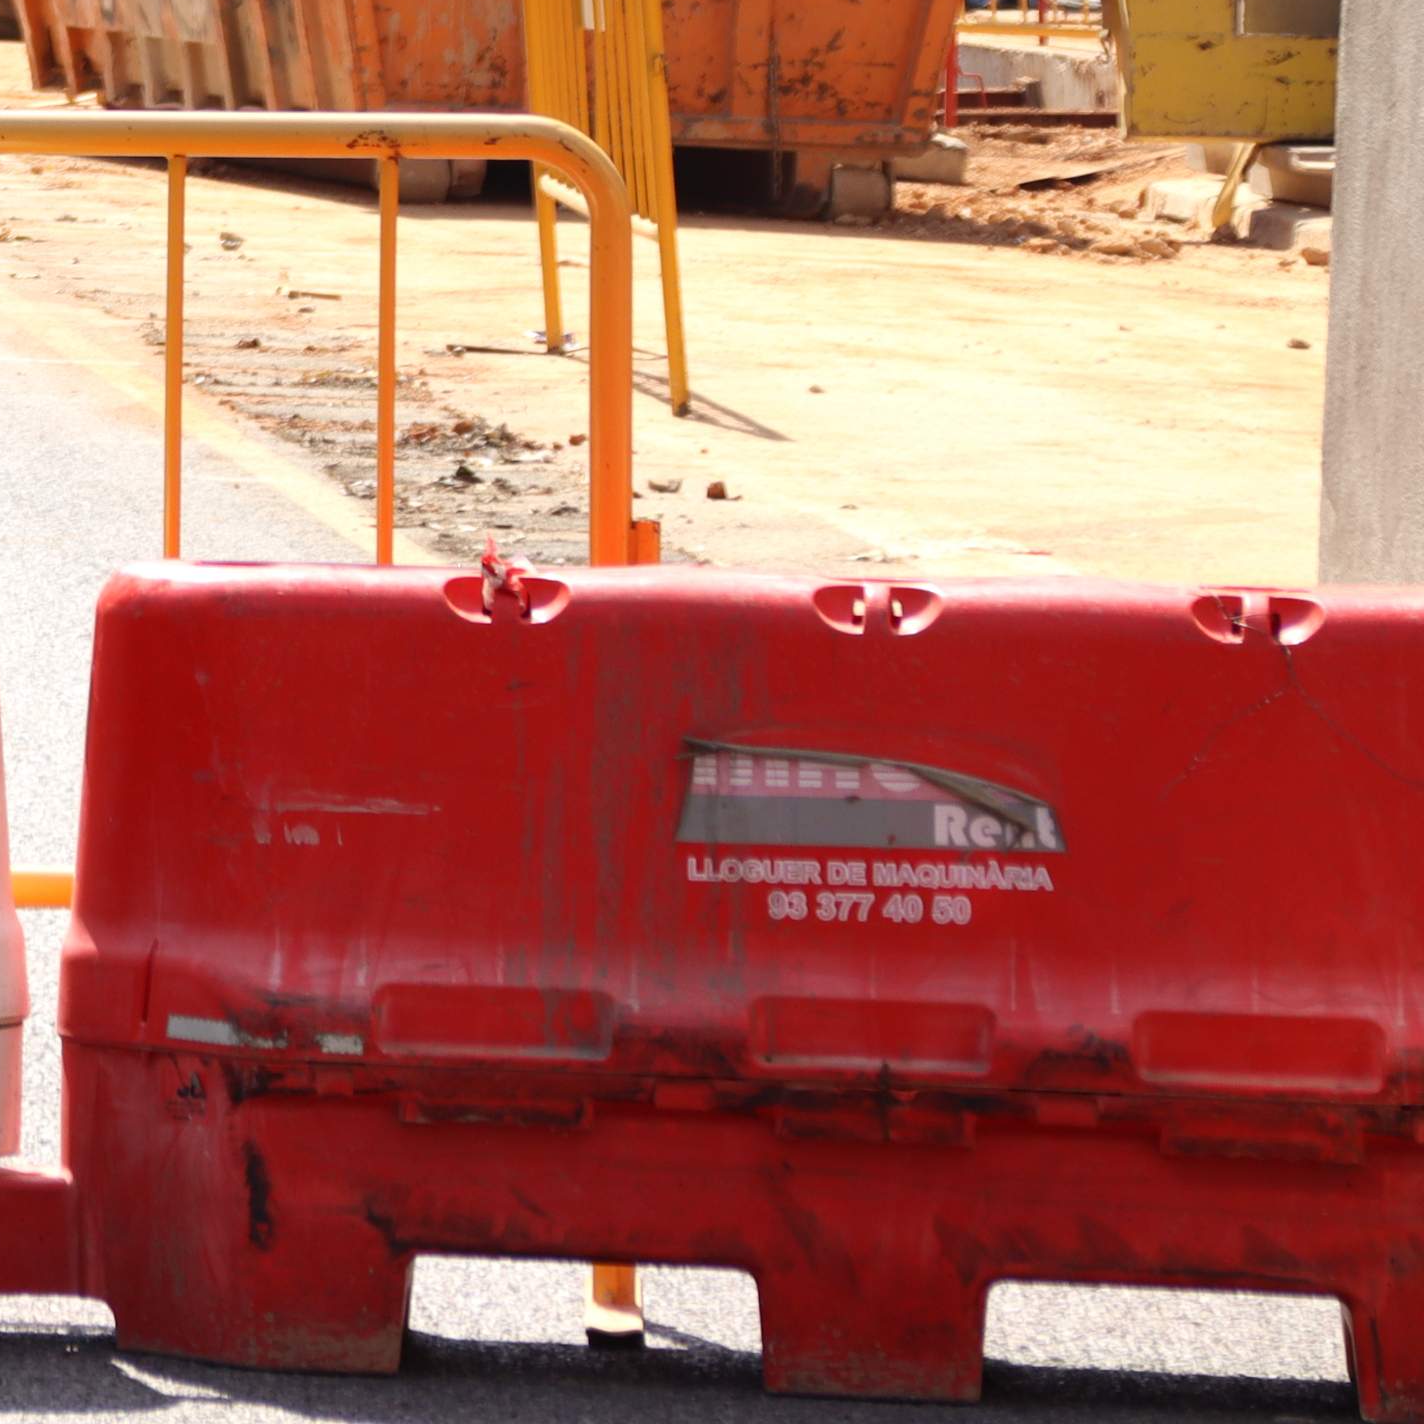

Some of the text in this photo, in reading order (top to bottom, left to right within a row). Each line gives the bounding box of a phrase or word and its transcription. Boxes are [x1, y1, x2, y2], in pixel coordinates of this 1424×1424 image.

[687, 857, 1054, 892] LLOGUER DE MAQUINÀRIA
[768, 889, 972, 925] 93 377 40 50
